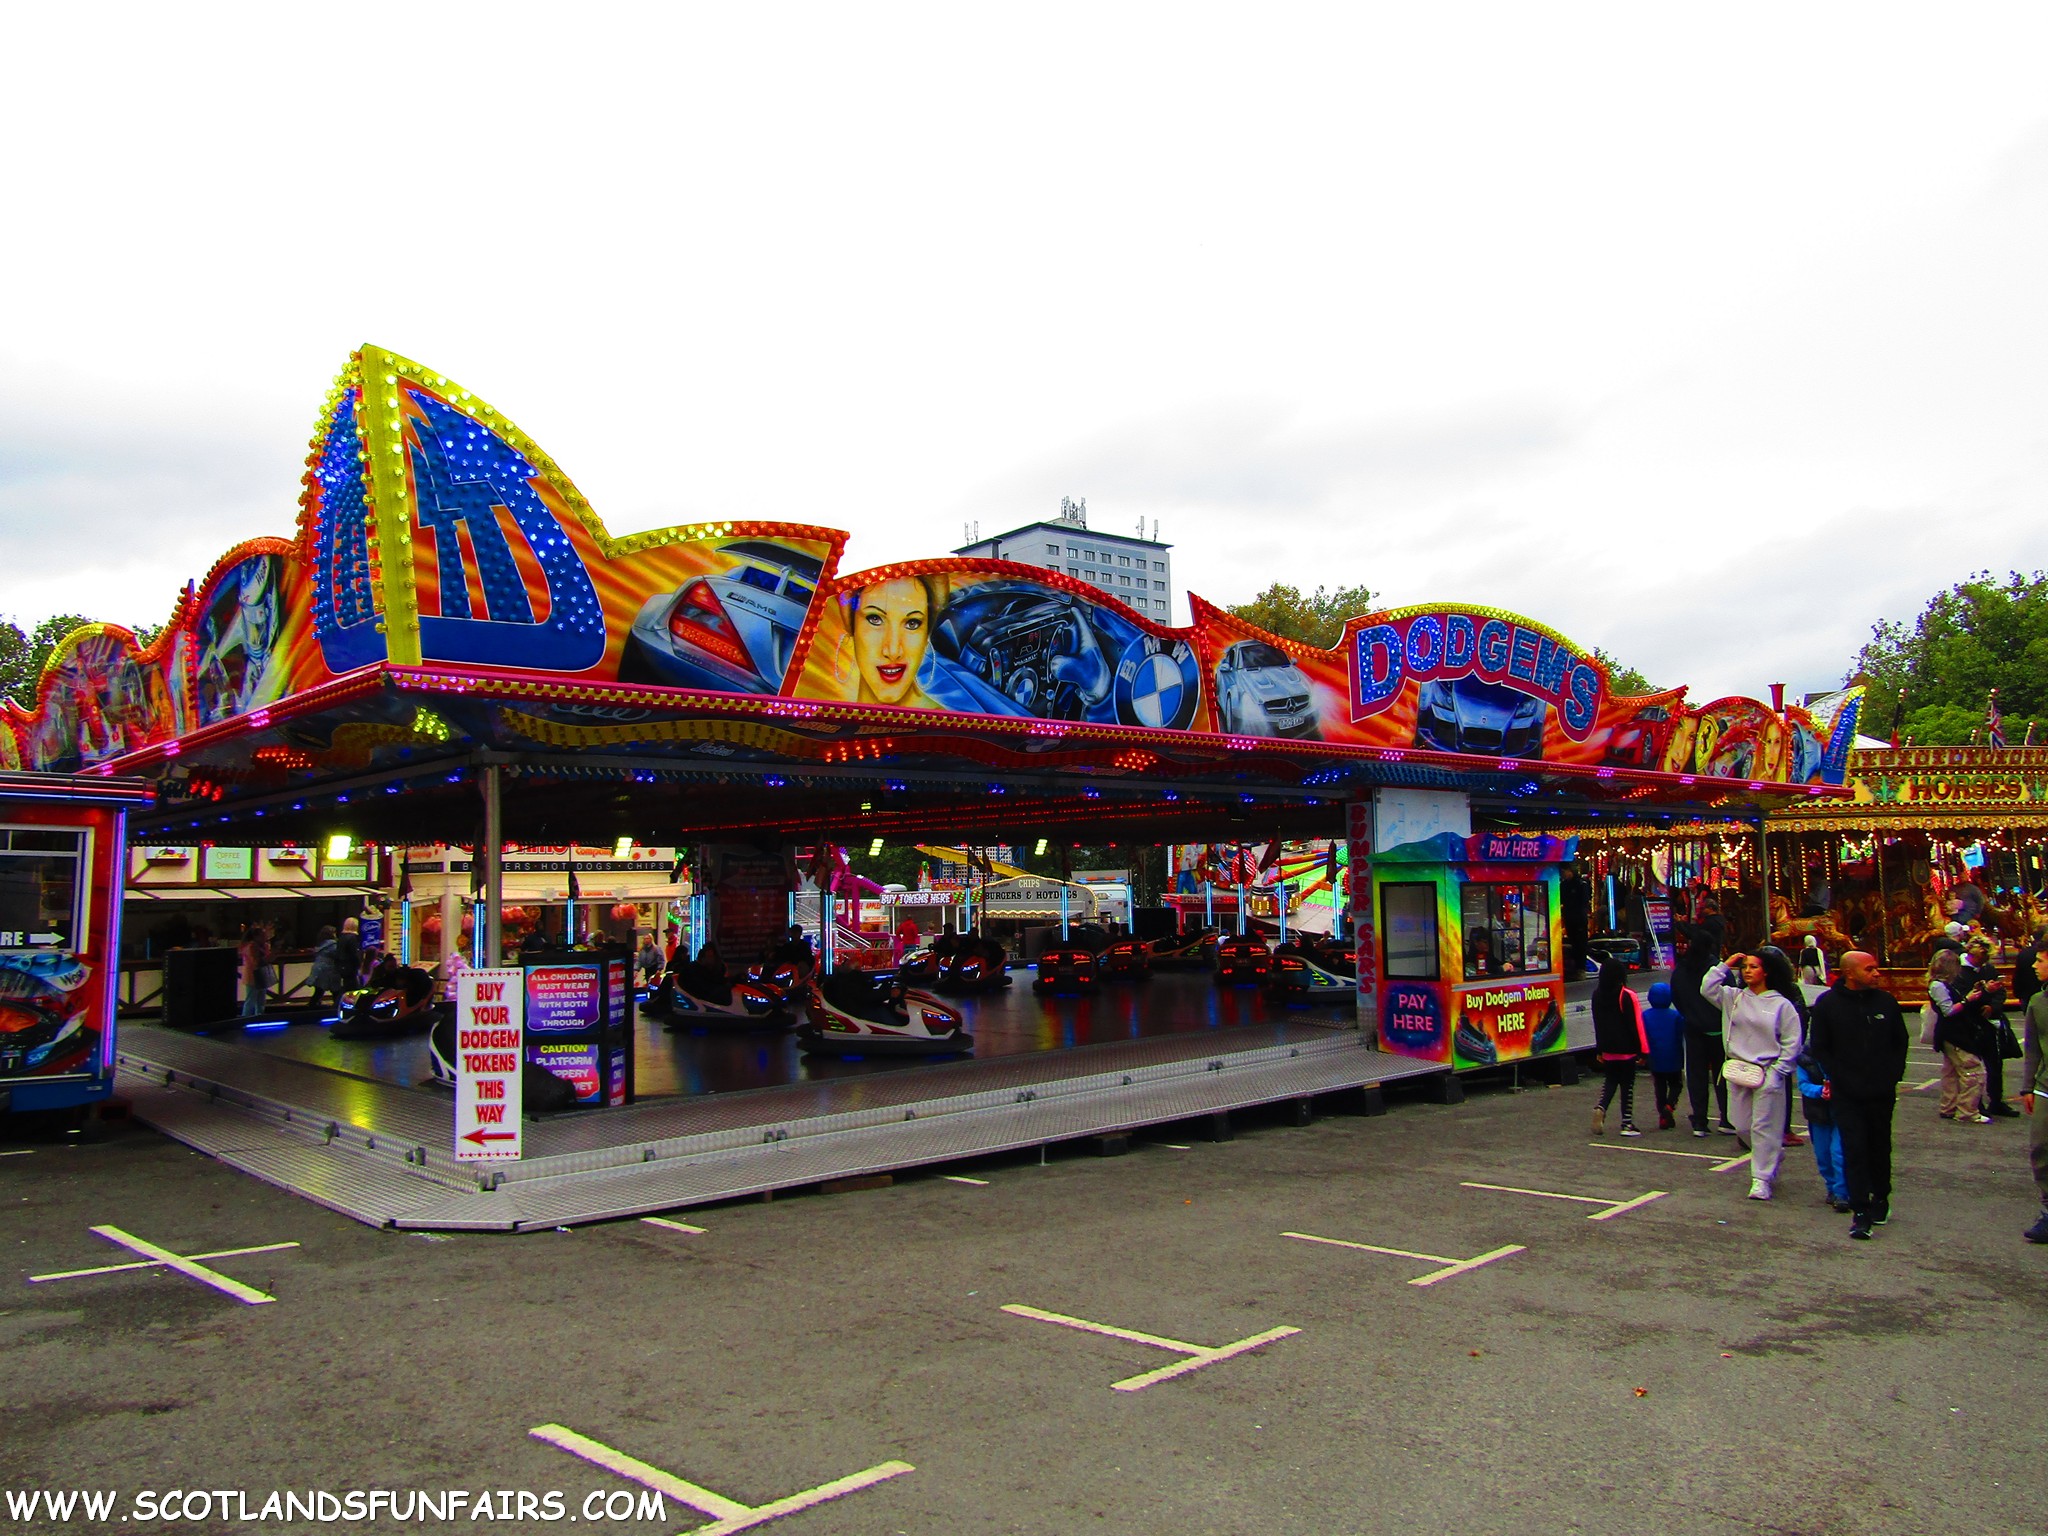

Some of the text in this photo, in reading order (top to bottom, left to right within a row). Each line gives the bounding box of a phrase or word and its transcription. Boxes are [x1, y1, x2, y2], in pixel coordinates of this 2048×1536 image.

[1119, 635, 1190, 684] BMW
[1356, 613, 1599, 731] DODGEM'S
[1907, 774, 2019, 800] HORSES
[1350, 804, 1370, 912] BUMPER
[1488, 840, 1541, 858] PAY HERE
[326, 867, 365, 878] WAFFLES
[463, 862, 665, 871] BERS HOT DOGS CHIPS
[1018, 879, 1041, 888] CHIPS
[880, 892, 952, 905] BUY TOKENS HERE
[985, 890, 1078, 900] BURGERS & HOTDGS
[1357, 922, 1376, 994] CARS
[550, 973, 596, 981] CHILDREN
[477, 983, 504, 1001] BUY
[537, 991, 589, 999] SEATBELTS
[1466, 987, 1550, 1011] Buy Dodgem Tokens
[1397, 993, 1428, 1010] PAY
[472, 1007, 509, 1024] YOUR
[541, 1019, 585, 1027] THROUGH
[1392, 1013, 1435, 1032] HERE
[1496, 1011, 1526, 1033] HERE
[461, 1030, 520, 1049] DODGEM
[540, 1044, 589, 1054] CAUTION
[465, 1054, 516, 1072] TOKENS
[536, 1056, 593, 1066] PLATFORM
[477, 1081, 504, 1099] THIS
[476, 1105, 505, 1123] WAY
